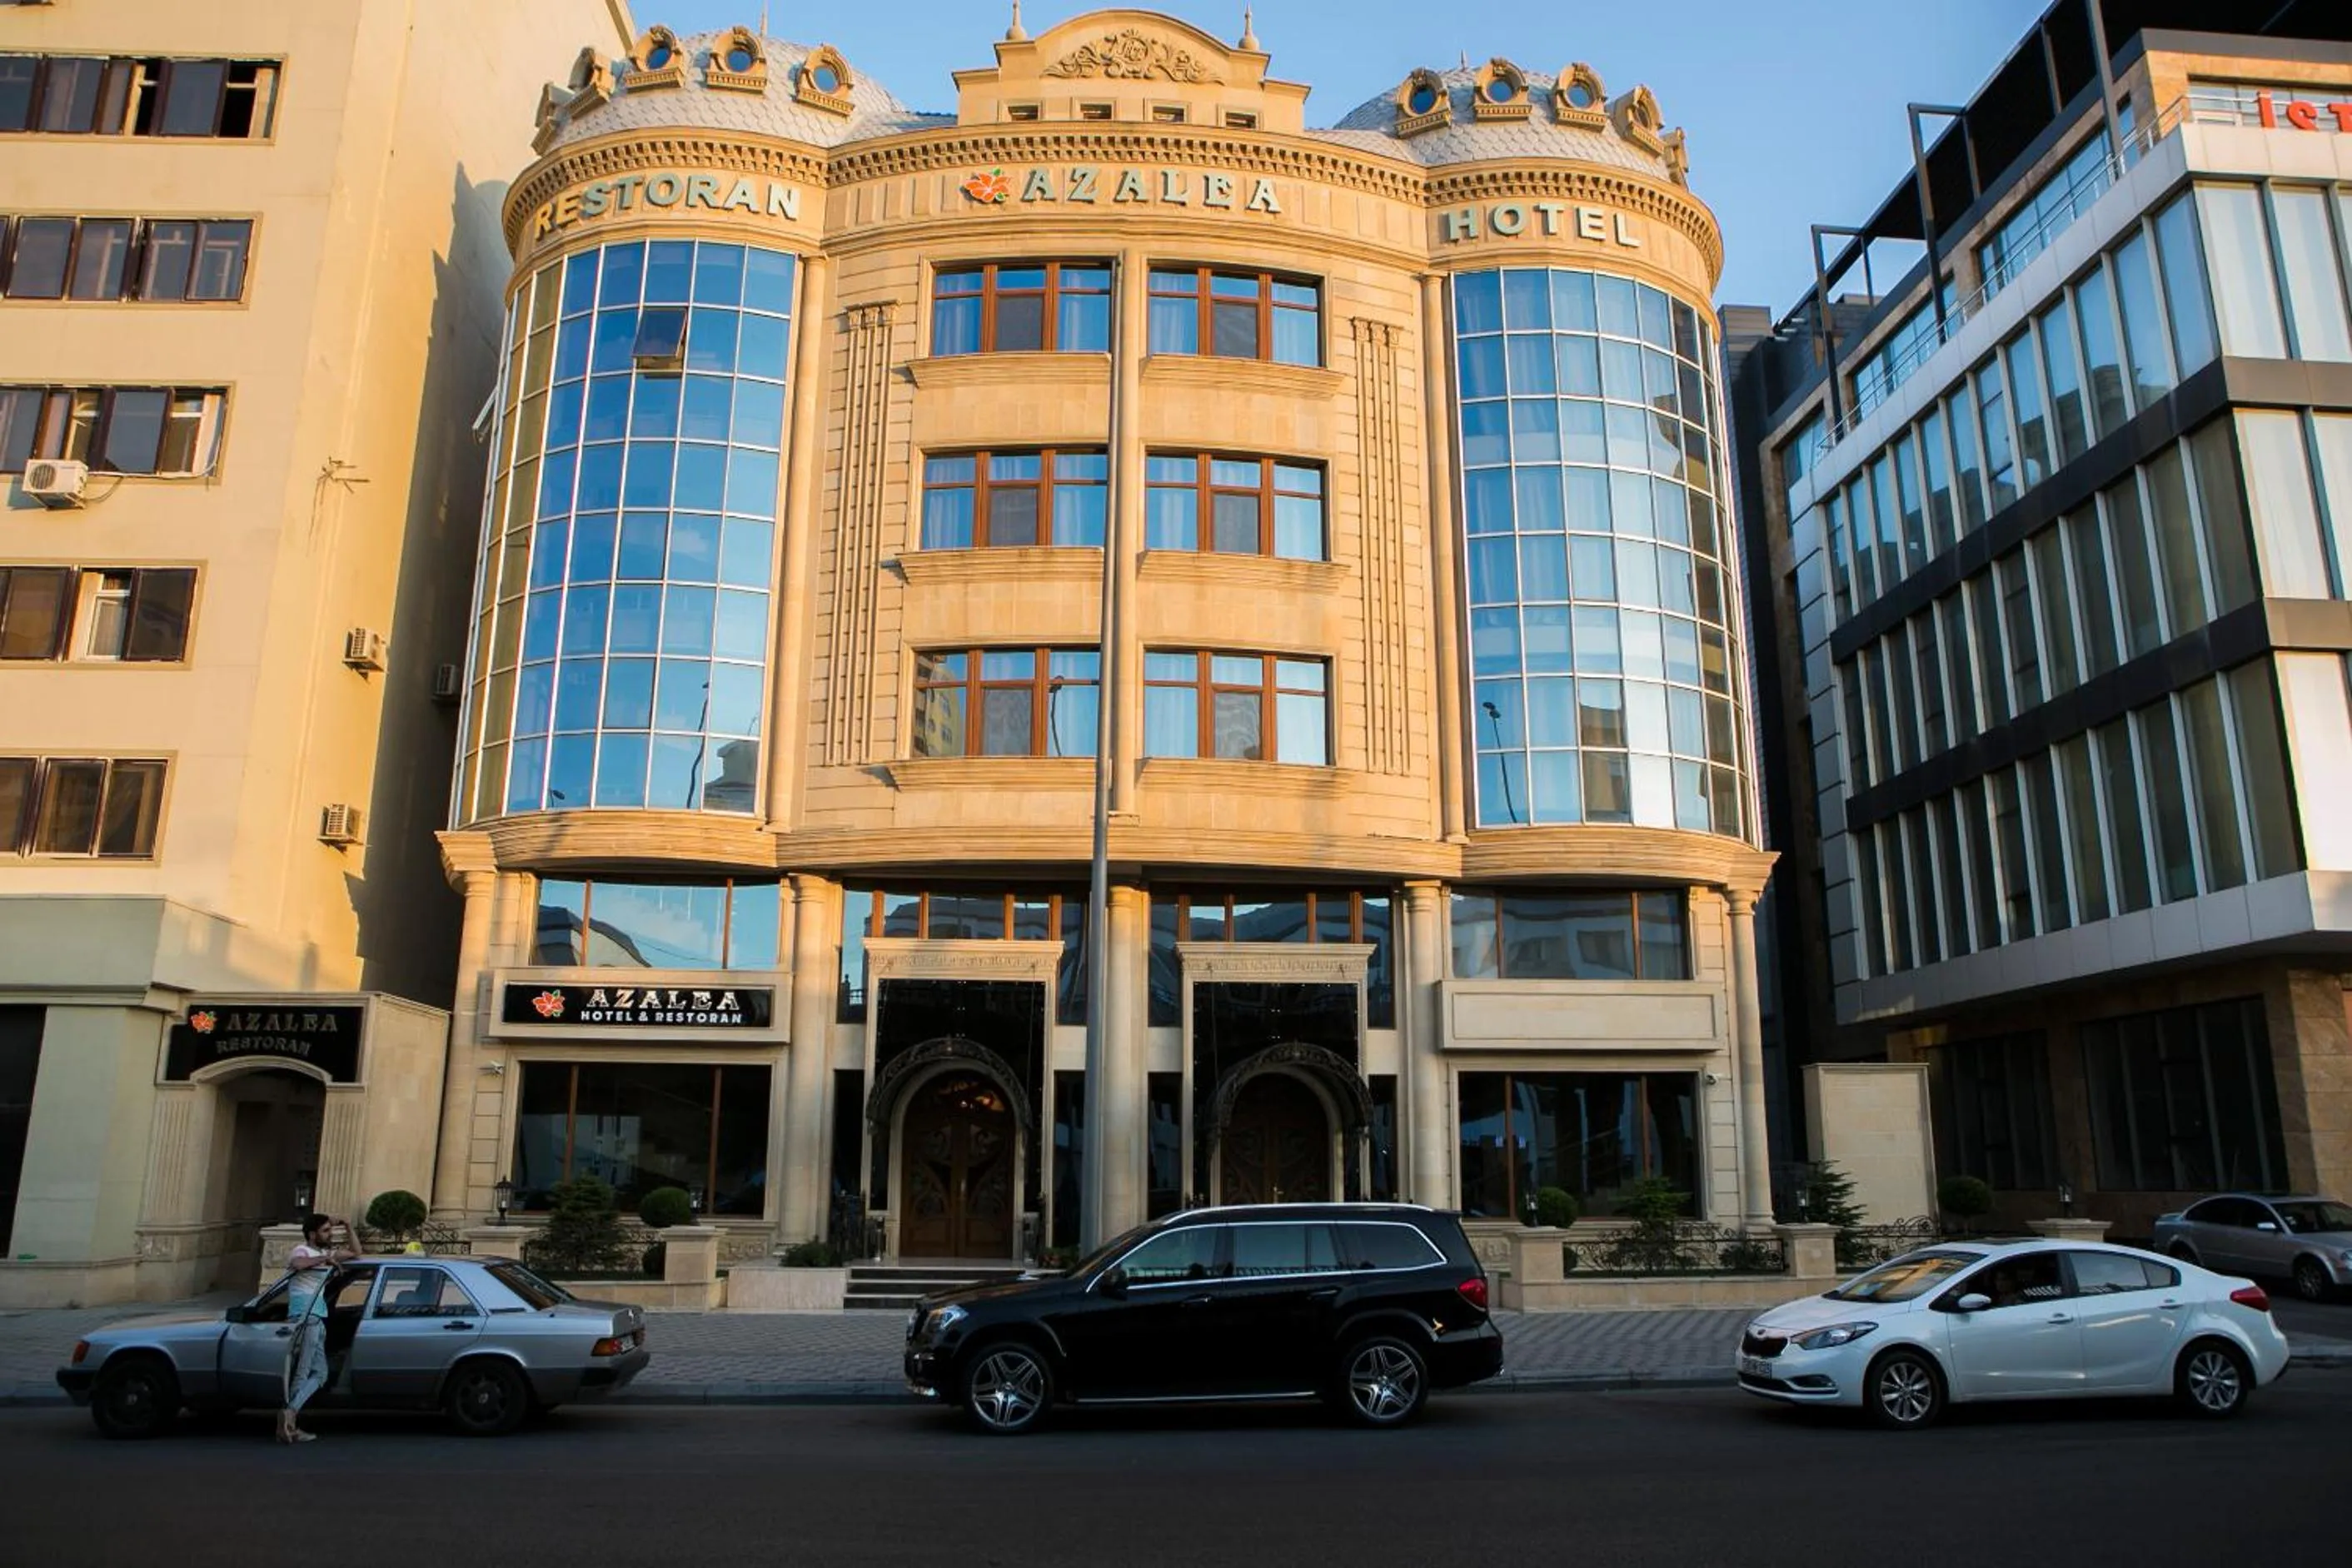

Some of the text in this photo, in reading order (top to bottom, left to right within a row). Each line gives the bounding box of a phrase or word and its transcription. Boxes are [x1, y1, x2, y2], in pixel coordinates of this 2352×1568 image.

[1022, 167, 1282, 213] AZALEA
[534, 172, 800, 240] RESTORAN
[1443, 202, 1641, 247] HOTEL
[586, 988, 740, 1010] AZALEA
[227, 1013, 338, 1032] AZALEA
[581, 1010, 742, 1023] HOTEL & RESTORAN
[217, 1036, 311, 1056] RESTORAN
